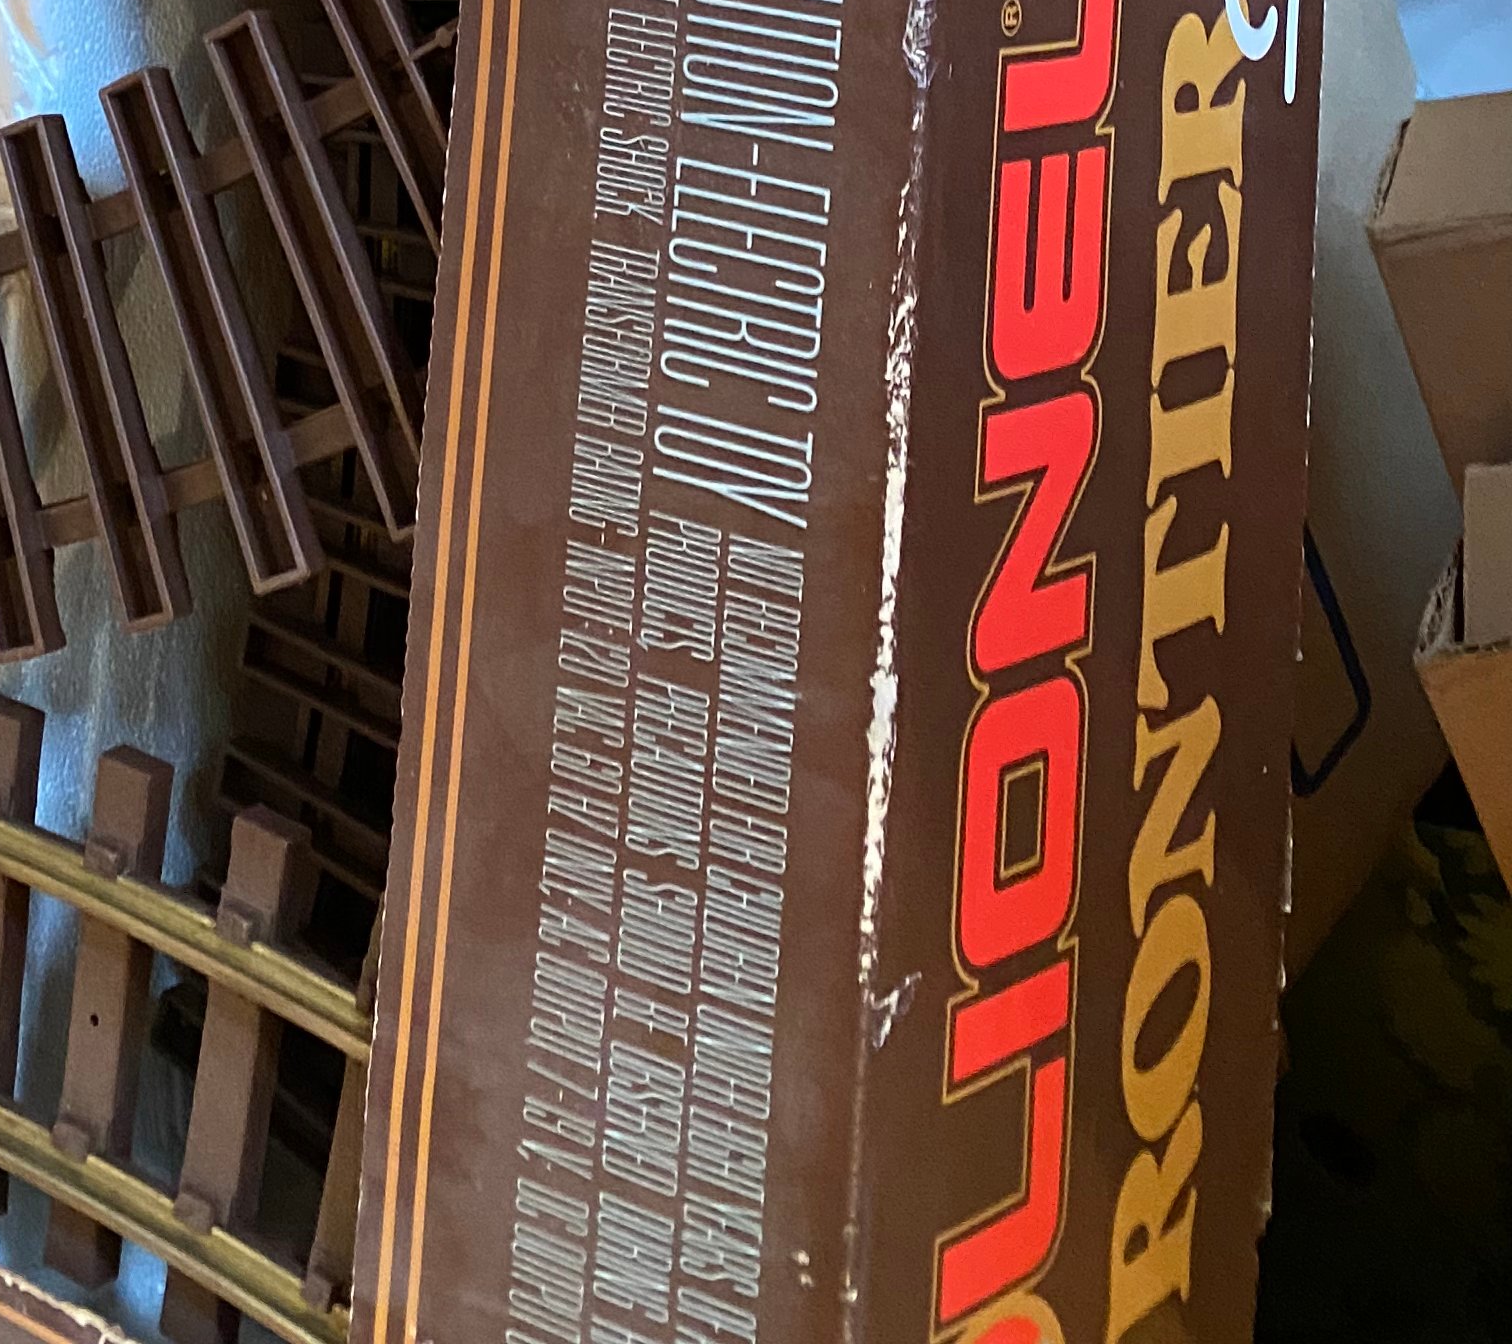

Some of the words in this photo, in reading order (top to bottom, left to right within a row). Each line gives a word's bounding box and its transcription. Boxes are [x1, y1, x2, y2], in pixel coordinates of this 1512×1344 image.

[601, 7, 677, 127] ELECTRIC
[593, 127, 669, 225] SHOCK.
[577, 240, 659, 436] TRANSFORMER
[652, 404, 813, 528] TOY
[725, 533, 803, 602] NOT
[553, 687, 625, 748] VAC
[712, 590, 800, 813] RECOMMENDED
[624, 672, 709, 869] PRECAUTIONS
[708, 802, 787, 873] FOR
[538, 903, 611, 963] AC
[617, 868, 696, 994] SHOULD
[699, 866, 783, 1016] CHILDREN
[527, 952, 606, 1074] OUTPUT
[613, 987, 688, 1047] BE
[691, 1004, 773, 1118] UNDER
[602, 1040, 684, 1196] OBSERVED
[516, 1178, 589, 1236] DC
[592, 1191, 674, 1322] DURING
[679, 1192, 763, 1296] YEARS
